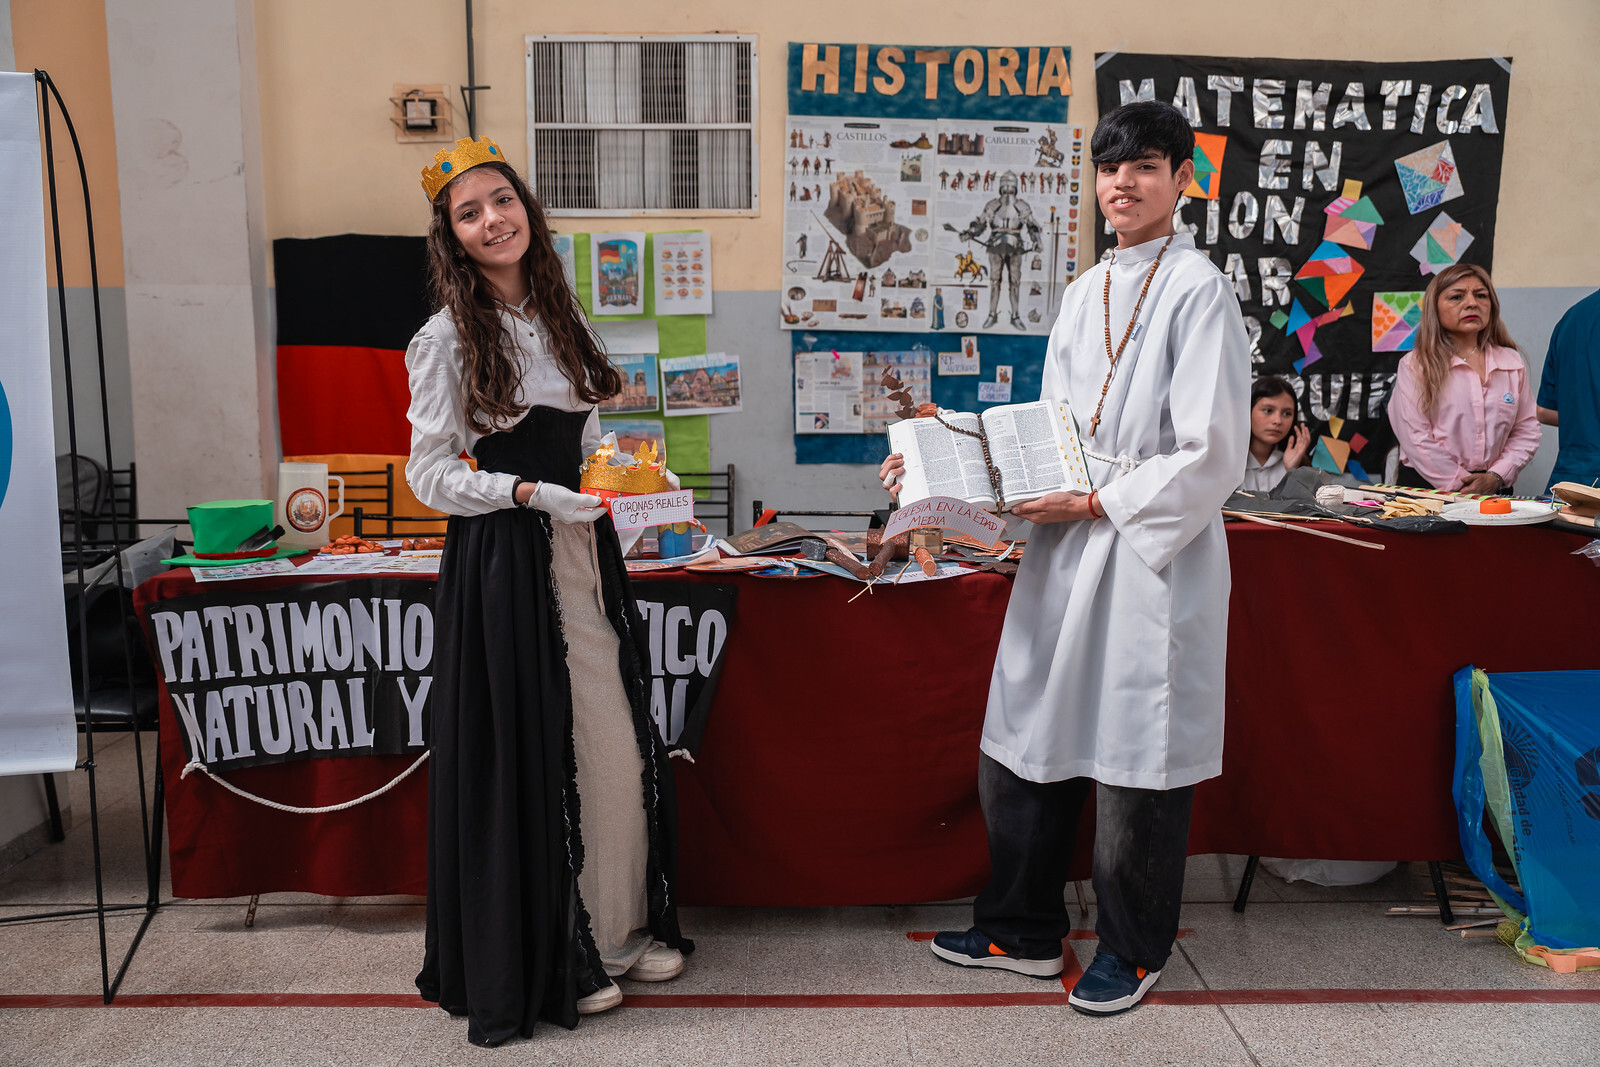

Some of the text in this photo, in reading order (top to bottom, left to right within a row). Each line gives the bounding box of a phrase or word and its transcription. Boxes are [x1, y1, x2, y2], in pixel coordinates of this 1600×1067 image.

[801, 44, 1073, 100] HISTORIA
[1119, 74, 1500, 135] MATEMATICA
[836, 132, 888, 141] CASTILLOS
[985, 136, 1037, 145] CABALLEROS
[1258, 138, 1342, 192] EN
[612, 496, 689, 514] CORONAS REALES
[890, 502, 998, 531] IGLESIA EN LA EDAD
[907, 516, 946, 528] MEDIA
[151, 598, 434, 683] PATRIMONIO
[171, 678, 375, 763] NATURAL
[396, 676, 433, 746] Y
